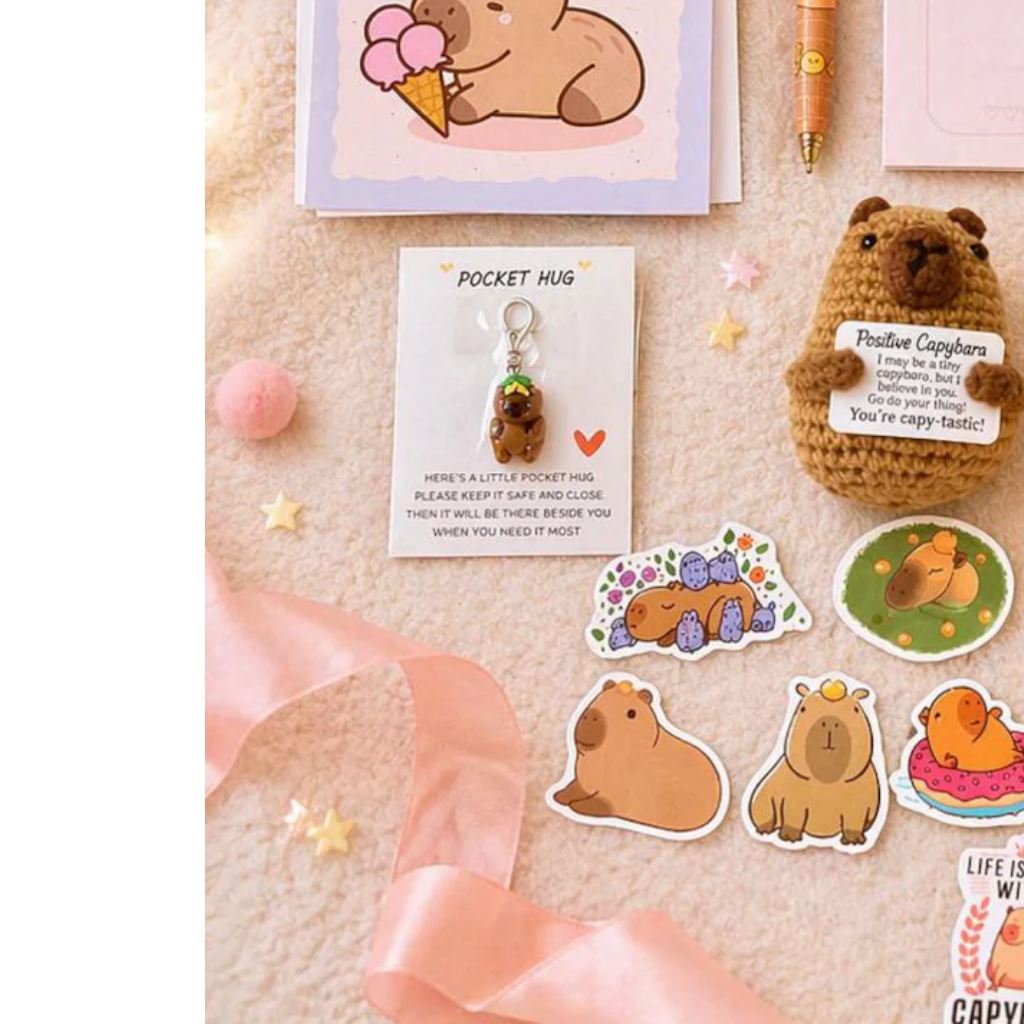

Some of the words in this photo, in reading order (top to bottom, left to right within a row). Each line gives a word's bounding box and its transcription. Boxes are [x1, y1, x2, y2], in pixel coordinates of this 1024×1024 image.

[457, 269, 531, 288] POCKET
[537, 269, 575, 287] HUG
[856, 328, 912, 350] Positive
[916, 332, 987, 359] Capybara
[877, 353, 883, 365] I
[885, 356, 910, 370] may
[912, 356, 927, 369] be
[929, 360, 937, 370] a
[939, 359, 962, 374] tiny
[935, 372, 954, 384] but
[956, 374, 961, 385] I
[877, 380, 918, 395] believe
[921, 384, 932, 395] in
[867, 393, 885, 405] Go
[886, 394, 902, 407] do
[904, 398, 931, 410] your
[850, 406, 896, 424] You're
[900, 413, 986, 432] capy-tastic!
[424, 472, 466, 483] HERE'S
[468, 473, 478, 483] A
[480, 472, 518, 483] LITTLE
[521, 472, 567, 483] POCKET
[569, 472, 594, 483] HUG
[414, 490, 459, 501] PLEASE
[461, 490, 492, 501] KEEP
[493, 490, 504, 500] IT
[506, 490, 536, 501] SAFE
[539, 490, 564, 500] AND
[406, 508, 438, 519] THEN
[440, 508, 451, 519] IT
[453, 508, 481, 519] WILL
[484, 508, 499, 519] BE
[502, 508, 540, 519] THERE
[543, 508, 584, 519] BESIDE
[587, 508, 612, 518] YOU
[432, 527, 470, 537] WHEN
[472, 526, 497, 537] YOU
[499, 526, 532, 537] NEED
[534, 526, 545, 536] IT
[547, 526, 581, 536] MOST
[967, 856, 1004, 877] LIFE
